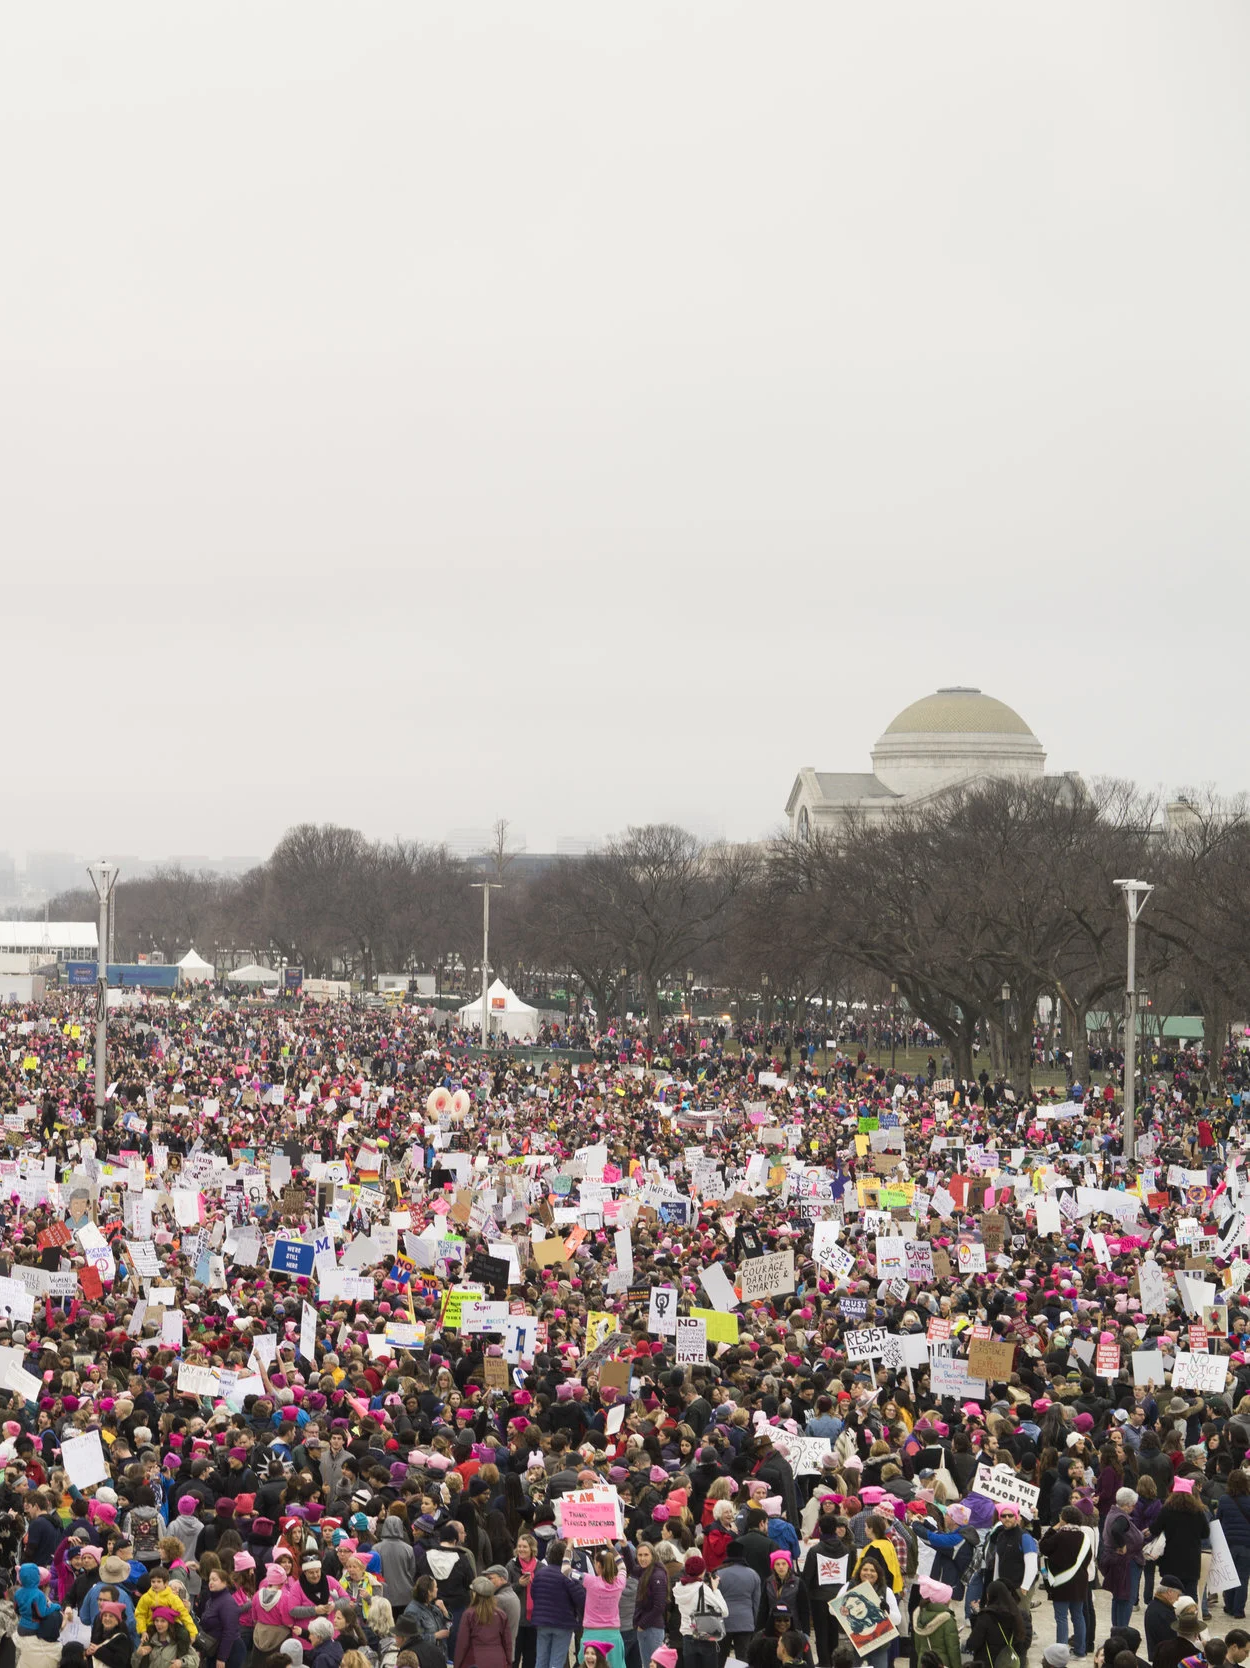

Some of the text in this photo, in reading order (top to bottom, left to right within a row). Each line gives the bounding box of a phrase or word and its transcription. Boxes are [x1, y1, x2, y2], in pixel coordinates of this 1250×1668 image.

[437, 1240, 454, 1249] RISE
[285, 1252, 298, 1261] STILL
[819, 1243, 833, 1260] Be
[906, 1251, 930, 1261] LAWS
[744, 1256, 764, 1267] Build
[829, 1249, 849, 1267] Kind
[881, 1257, 901, 1268] HER
[285, 1261, 298, 1269] HERE
[397, 1258, 413, 1271] NO
[21, 1272, 41, 1282] STILL
[746, 1270, 788, 1286] DARING &
[424, 1280, 437, 1289] NO
[747, 1279, 780, 1294] SMARTS
[840, 1299, 867, 1307] TRUST
[840, 1306, 866, 1314] WOMEN
[677, 1319, 698, 1328] NO
[845, 1327, 887, 1347] RESIST
[677, 1352, 704, 1363] HATE
[1191, 1354, 1210, 1365] NO
[180, 1363, 195, 1374] GAY
[933, 1359, 952, 1370] When
[1178, 1362, 1220, 1376] JUSTICE
[1190, 1372, 1205, 1380] NO
[1178, 1378, 1216, 1392] PEACE
[994, 1475, 1037, 1498] ARE THE
[579, 1492, 596, 1503] AM
[980, 1481, 1035, 1510] MAJORITY
